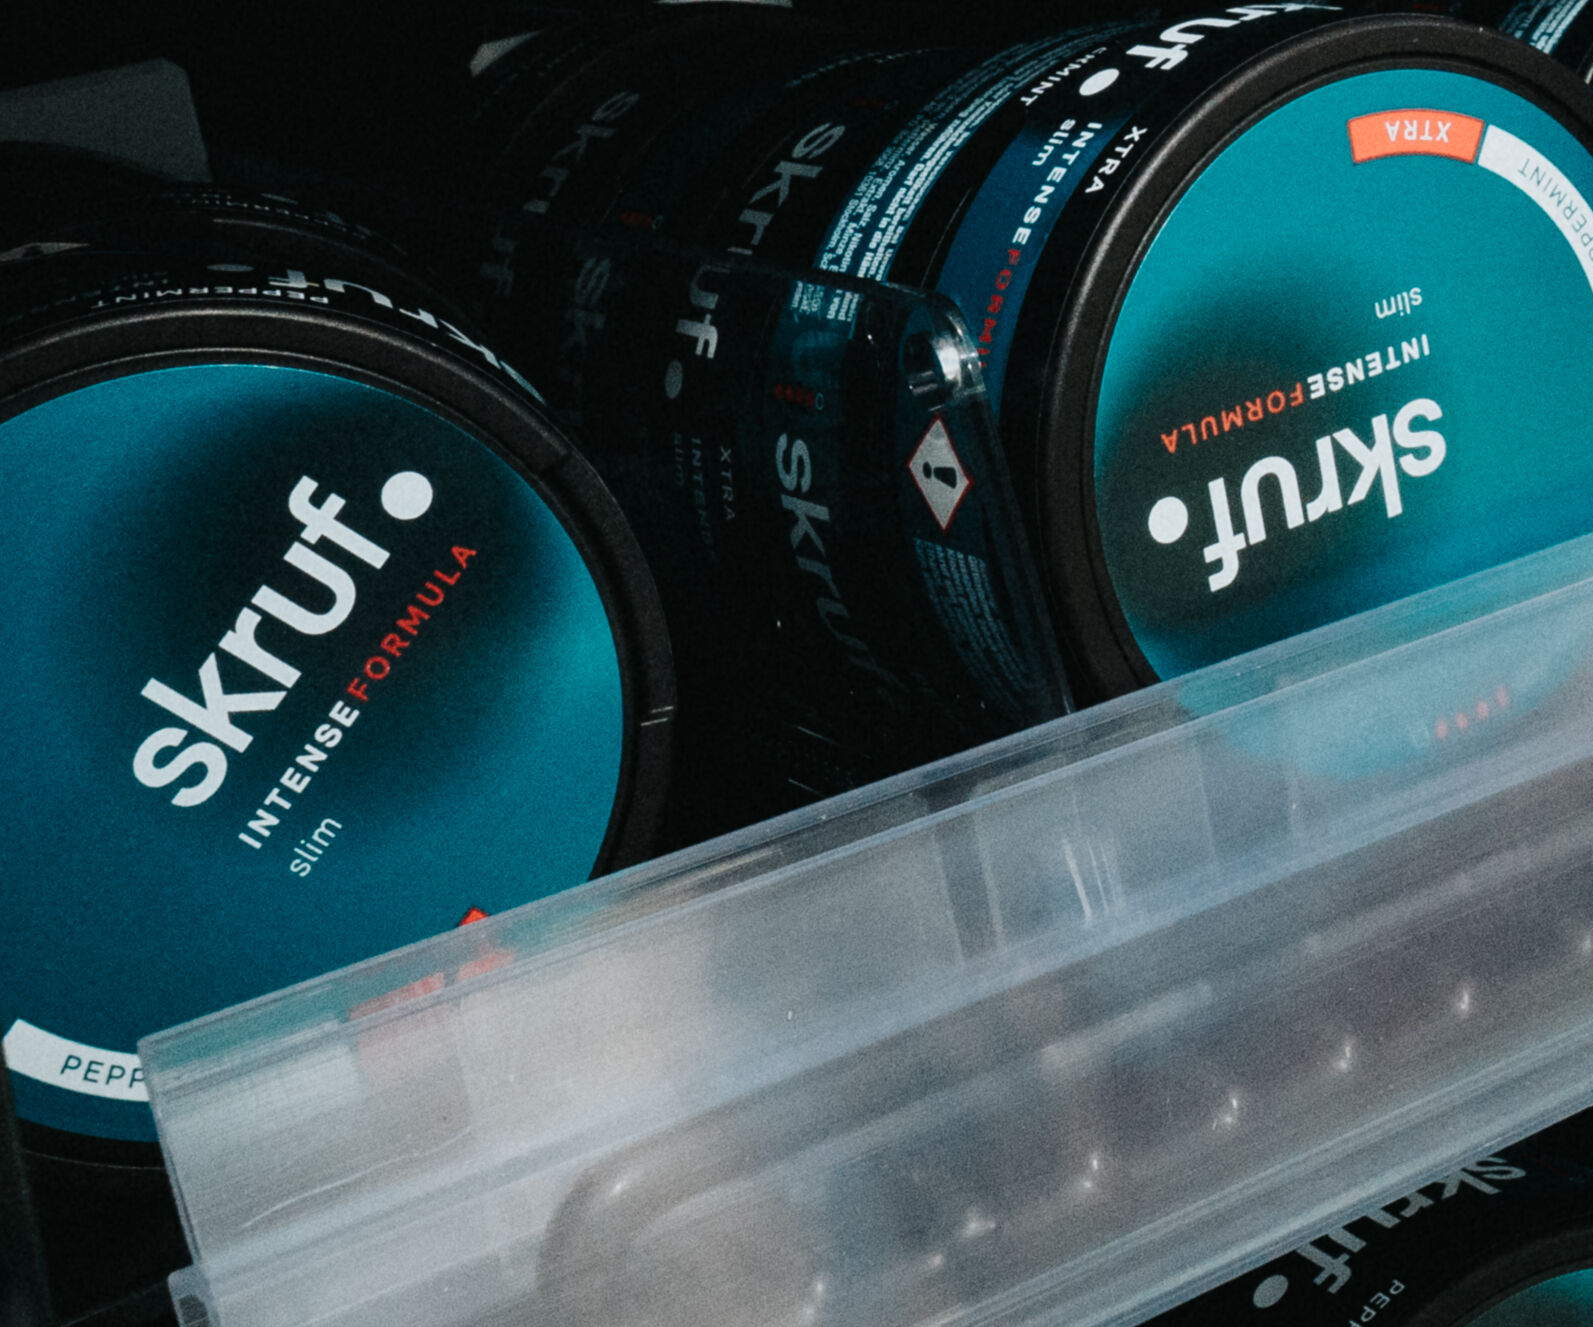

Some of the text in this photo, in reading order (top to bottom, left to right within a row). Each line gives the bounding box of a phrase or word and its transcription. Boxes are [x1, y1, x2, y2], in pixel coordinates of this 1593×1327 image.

[1031, 118, 1076, 168] slim
[1384, 119, 1453, 143] XTRA
[1084, 126, 1149, 195] XTRA
[1374, 287, 1424, 320] slim
[289, 816, 343, 877] slim
